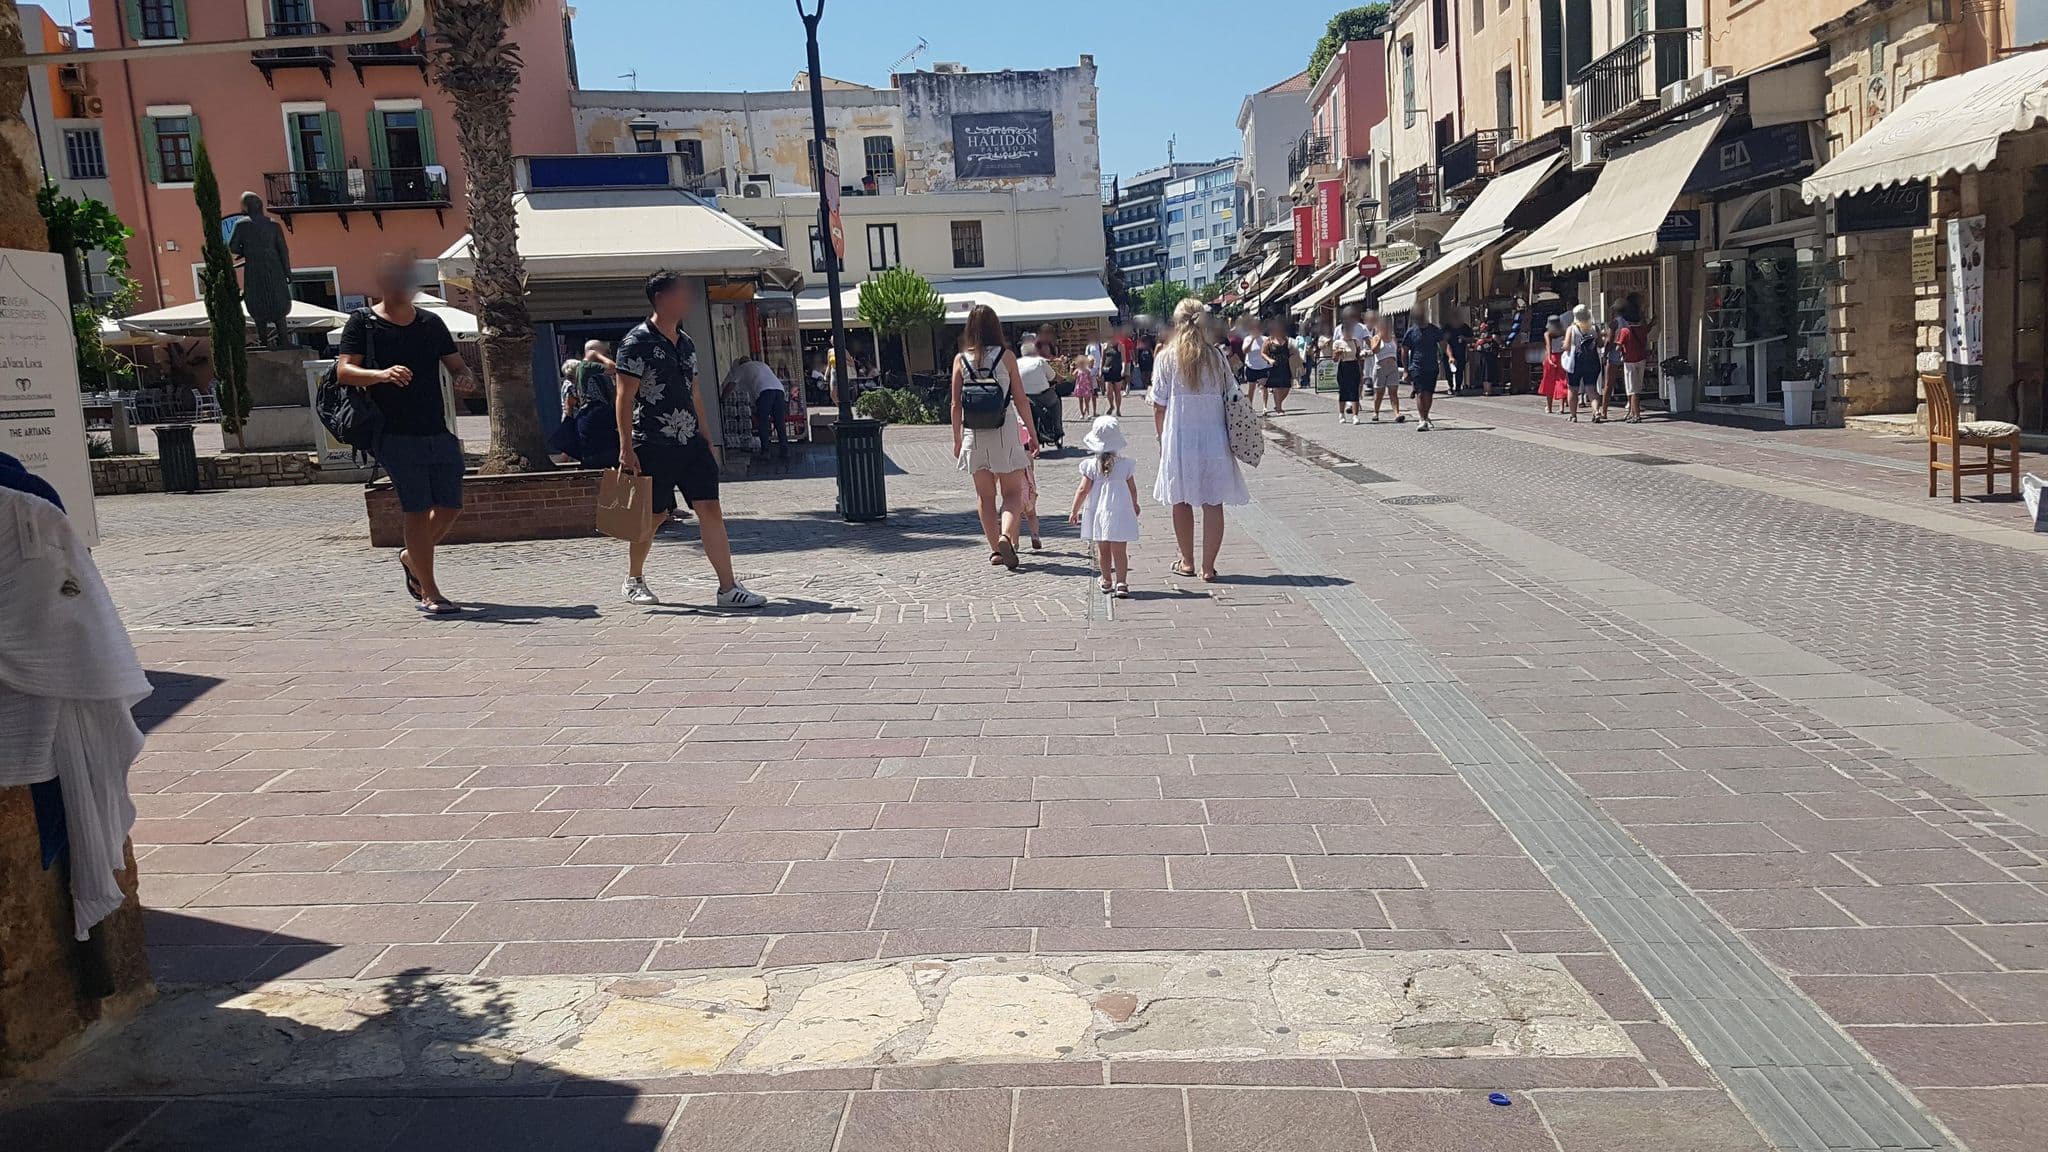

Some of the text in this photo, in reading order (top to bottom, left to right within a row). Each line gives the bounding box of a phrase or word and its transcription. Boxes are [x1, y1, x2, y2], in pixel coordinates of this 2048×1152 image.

[967, 133, 1037, 148] HALIDON
[981, 145, 1026, 153] PANSION
[1320, 188, 1329, 240] SHOWROOM
[1295, 214, 1303, 258] SHOWROOM
[1381, 248, 1414, 259] Healthier
[9, 426, 52, 438] THE ARTIANS
